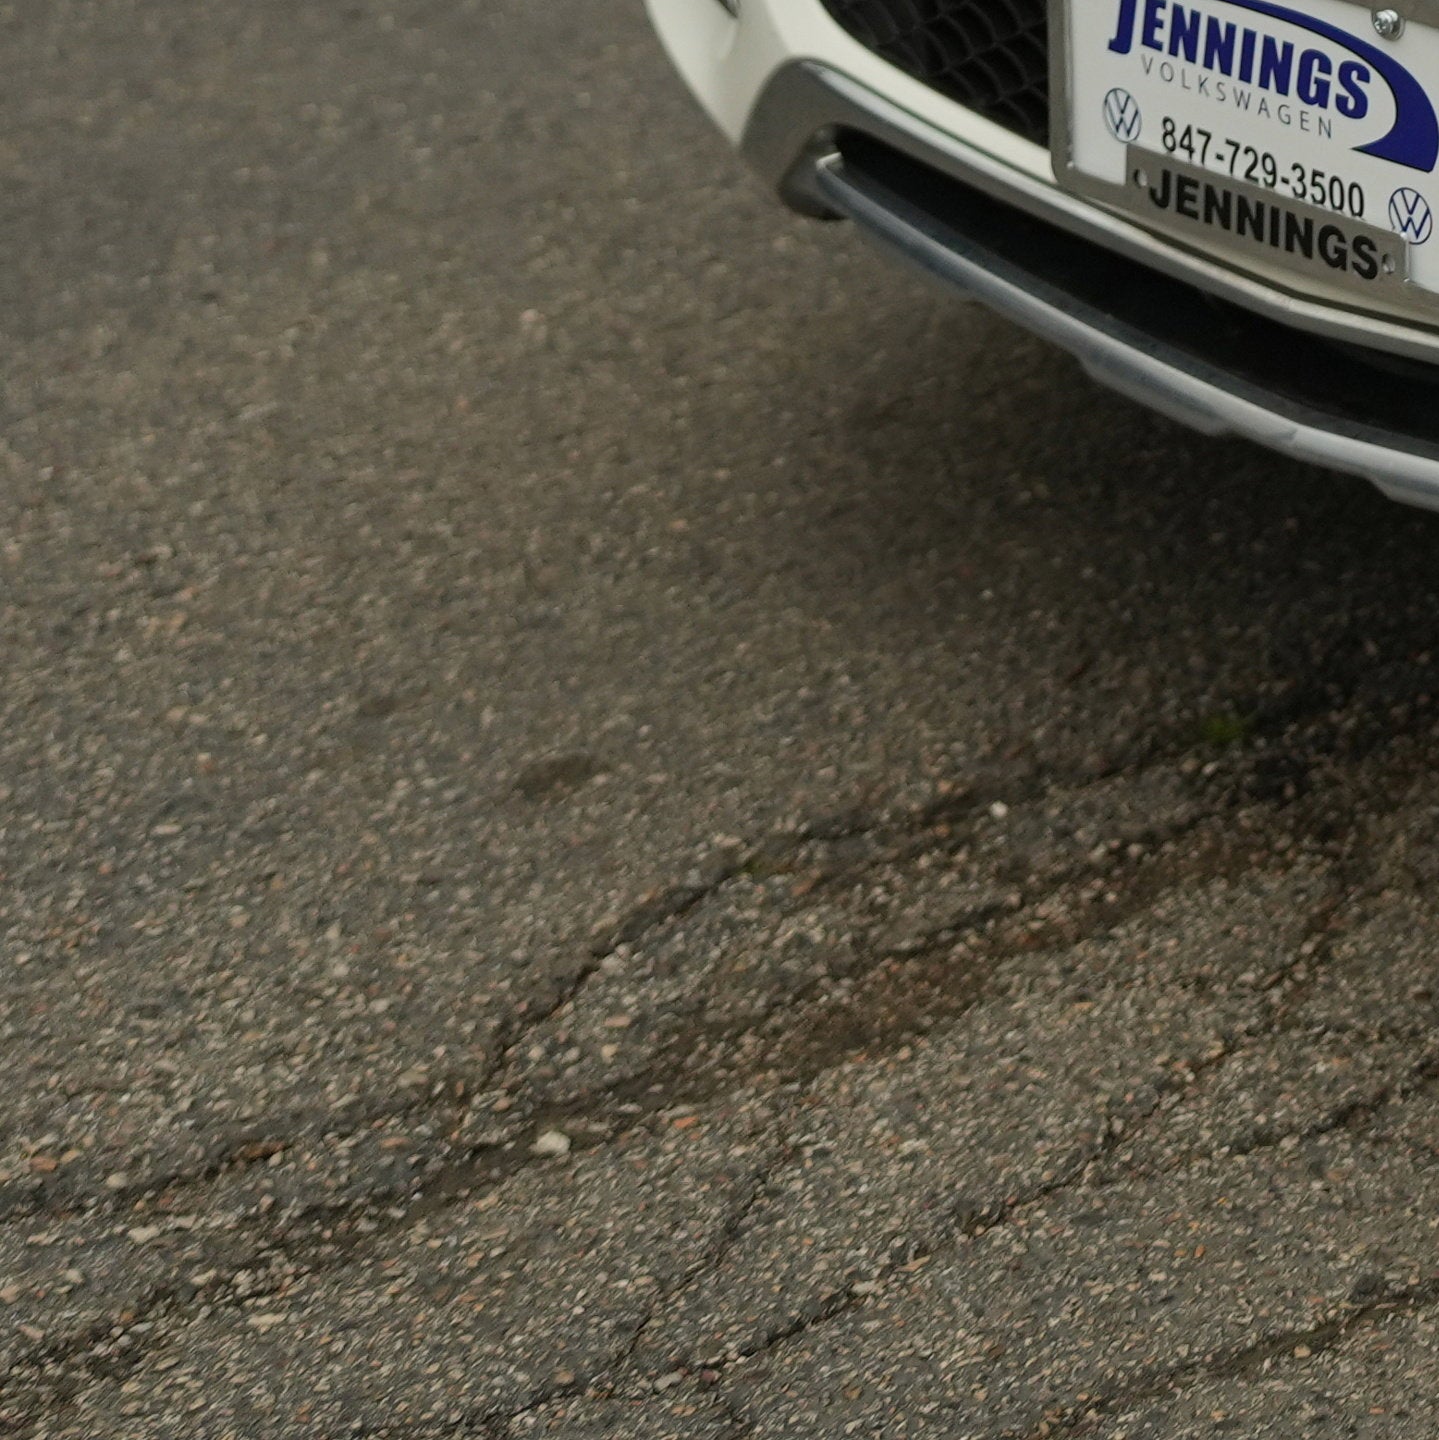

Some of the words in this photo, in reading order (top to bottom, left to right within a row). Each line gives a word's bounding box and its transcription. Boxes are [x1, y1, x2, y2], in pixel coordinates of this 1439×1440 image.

[1140, 53, 1333, 139] VOLKSWAGEN
[1161, 116, 1365, 219] 847-729-3500
[1149, 168, 1379, 281] JENNINGS
